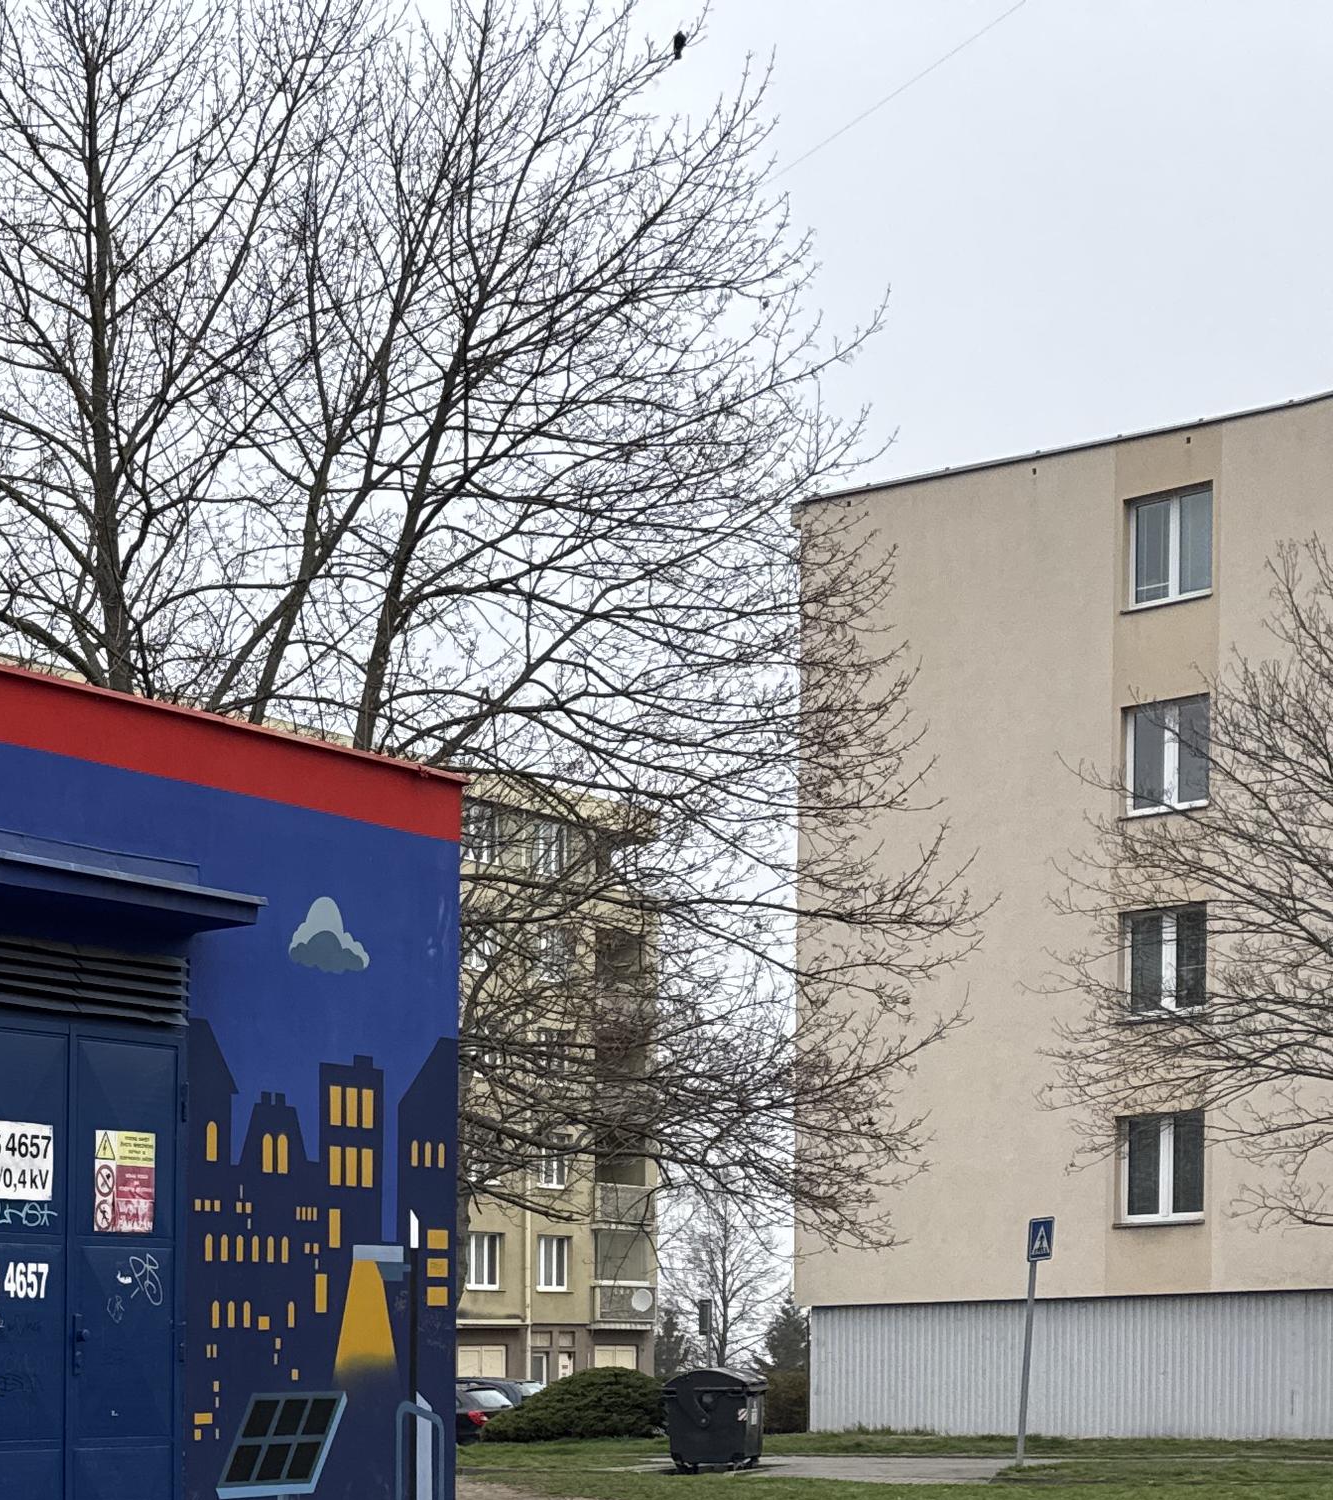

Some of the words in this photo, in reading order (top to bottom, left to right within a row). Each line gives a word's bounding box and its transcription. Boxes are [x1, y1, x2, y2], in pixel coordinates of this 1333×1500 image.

[5, 1133, 51, 1159] 4657
[30, 1169, 49, 1190] kV
[4, 1261, 49, 1299] 4657
